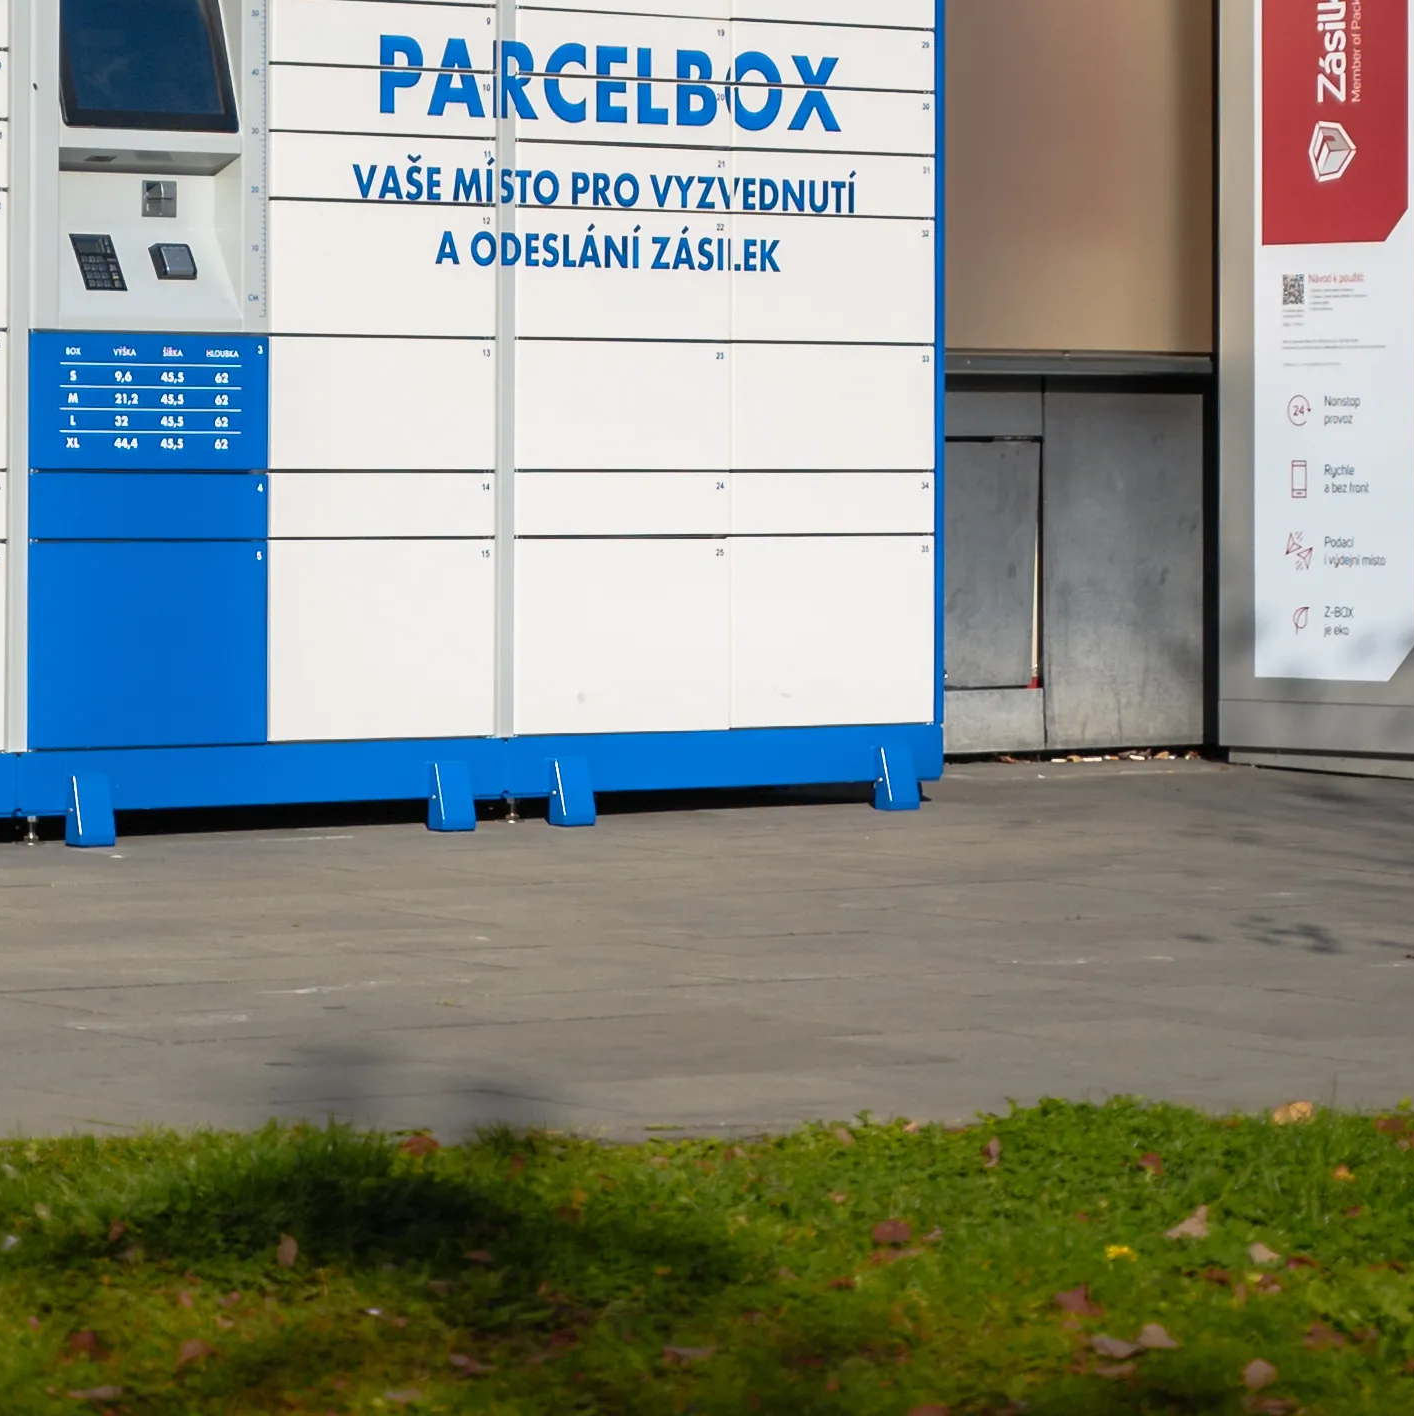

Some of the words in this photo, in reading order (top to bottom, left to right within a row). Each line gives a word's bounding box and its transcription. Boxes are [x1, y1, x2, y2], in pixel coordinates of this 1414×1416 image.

[1351, 33, 1361, 45] of
[1351, 48, 1361, 103] Member
[379, 34, 842, 132] PARCELBOX
[352, 154, 441, 202] VAŠE
[454, 157, 560, 206] MÍSTO
[571, 172, 640, 208] PRO
[650, 170, 857, 214] VYZVEDNUTÍ
[435, 230, 460, 265] A
[470, 223, 641, 269] ODESLÁNÍ
[651, 225, 781, 273] ZÁSILEK
[66, 347, 81, 356] BOX
[113, 346, 137, 357] VÝŠKA
[69, 370, 77, 382] S
[114, 371, 132, 382] 9,6
[160, 372, 184, 383] 45,5
[215, 373, 229, 383] 62
[68, 393, 79, 404] M
[115, 393, 139, 405] 21,2
[160, 394, 184, 405] 45,5
[215, 395, 229, 405] 62
[1324, 396, 1361, 408] Nonstop
[1293, 405, 1304, 416] 24
[70, 415, 76, 426] L
[114, 416, 129, 427] 32
[160, 416, 184, 428] 45,5
[214, 417, 228, 427] 62
[1324, 415, 1353, 426] provoz
[66, 437, 80, 449] XL
[114, 438, 138, 449] 44,4
[160, 438, 184, 449] 45,5
[214, 439, 228, 449] 62
[1324, 464, 1355, 478] Rychle
[1324, 484, 1329, 493] a
[1332, 482, 1347, 493] bez
[1349, 482, 1369, 493] front
[1324, 536, 1354, 548] Podací
[1329, 554, 1360, 568] výdejní
[1361, 555, 1386, 566] místo
[1324, 606, 1354, 618] Z-BOX
[1324, 625, 1332, 637] je
[1334, 625, 1349, 636] eko
